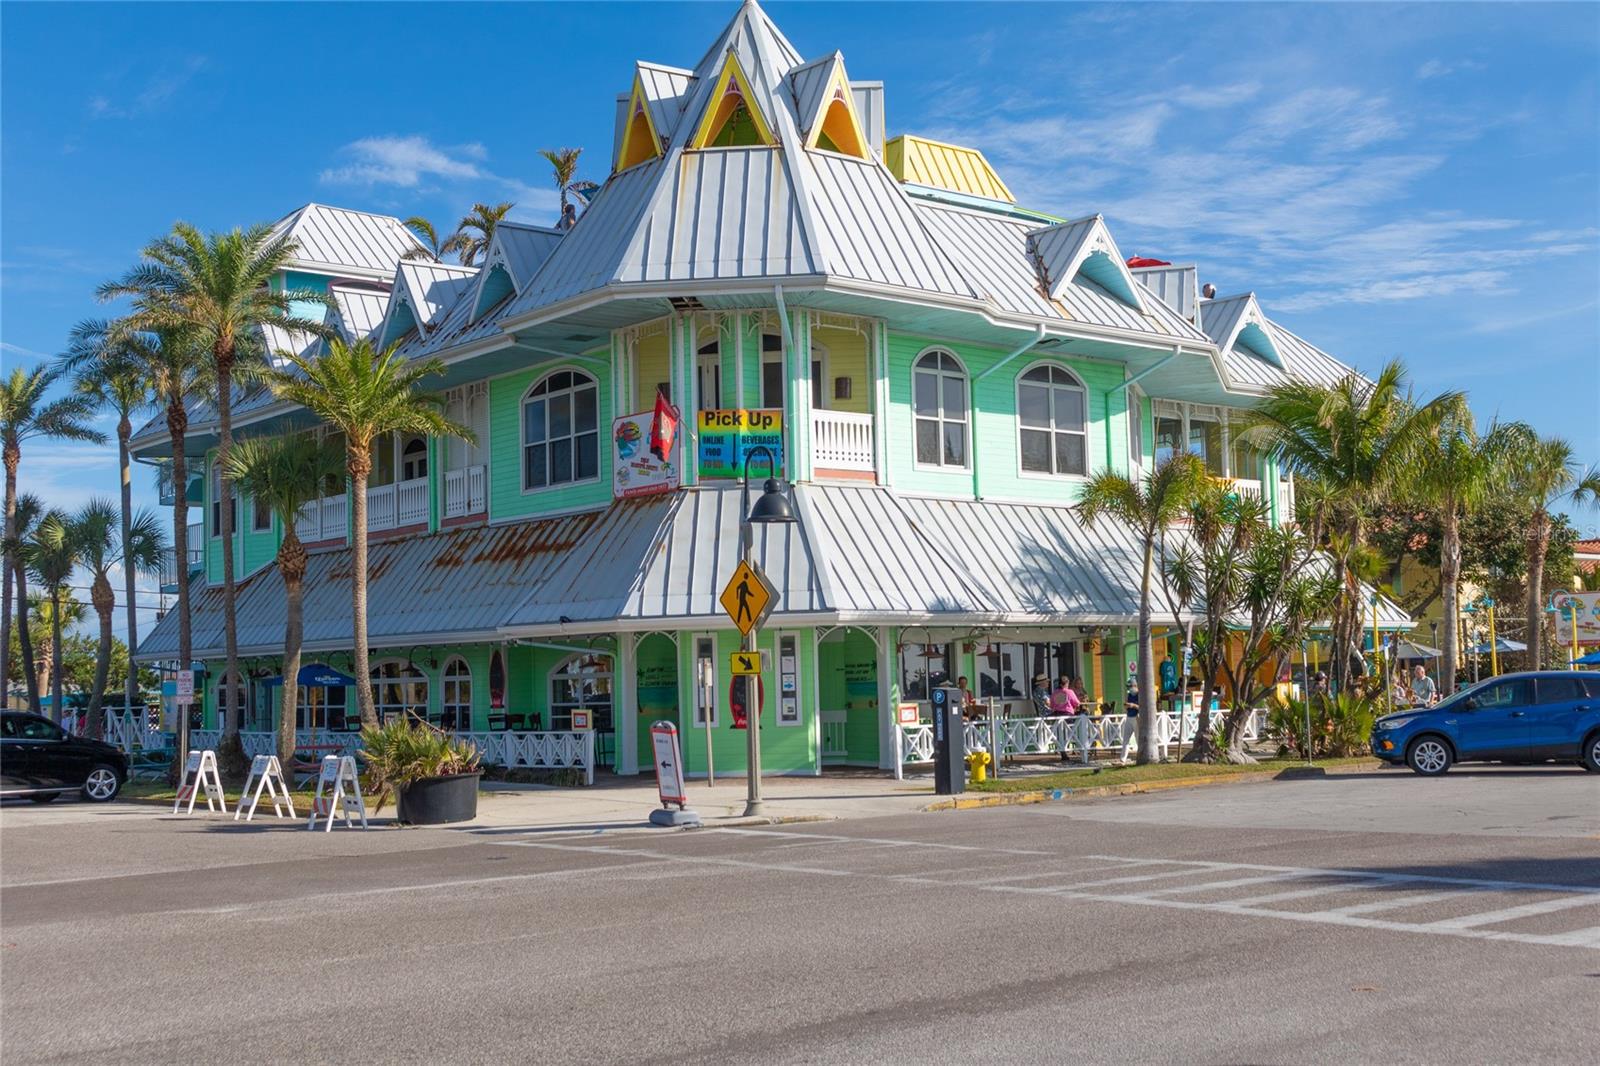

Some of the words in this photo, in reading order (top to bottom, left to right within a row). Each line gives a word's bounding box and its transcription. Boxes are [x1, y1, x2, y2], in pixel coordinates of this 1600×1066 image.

[705, 411, 742, 426] Pick
[749, 412, 772, 430] Up
[741, 435, 780, 445] BEVERAGES
